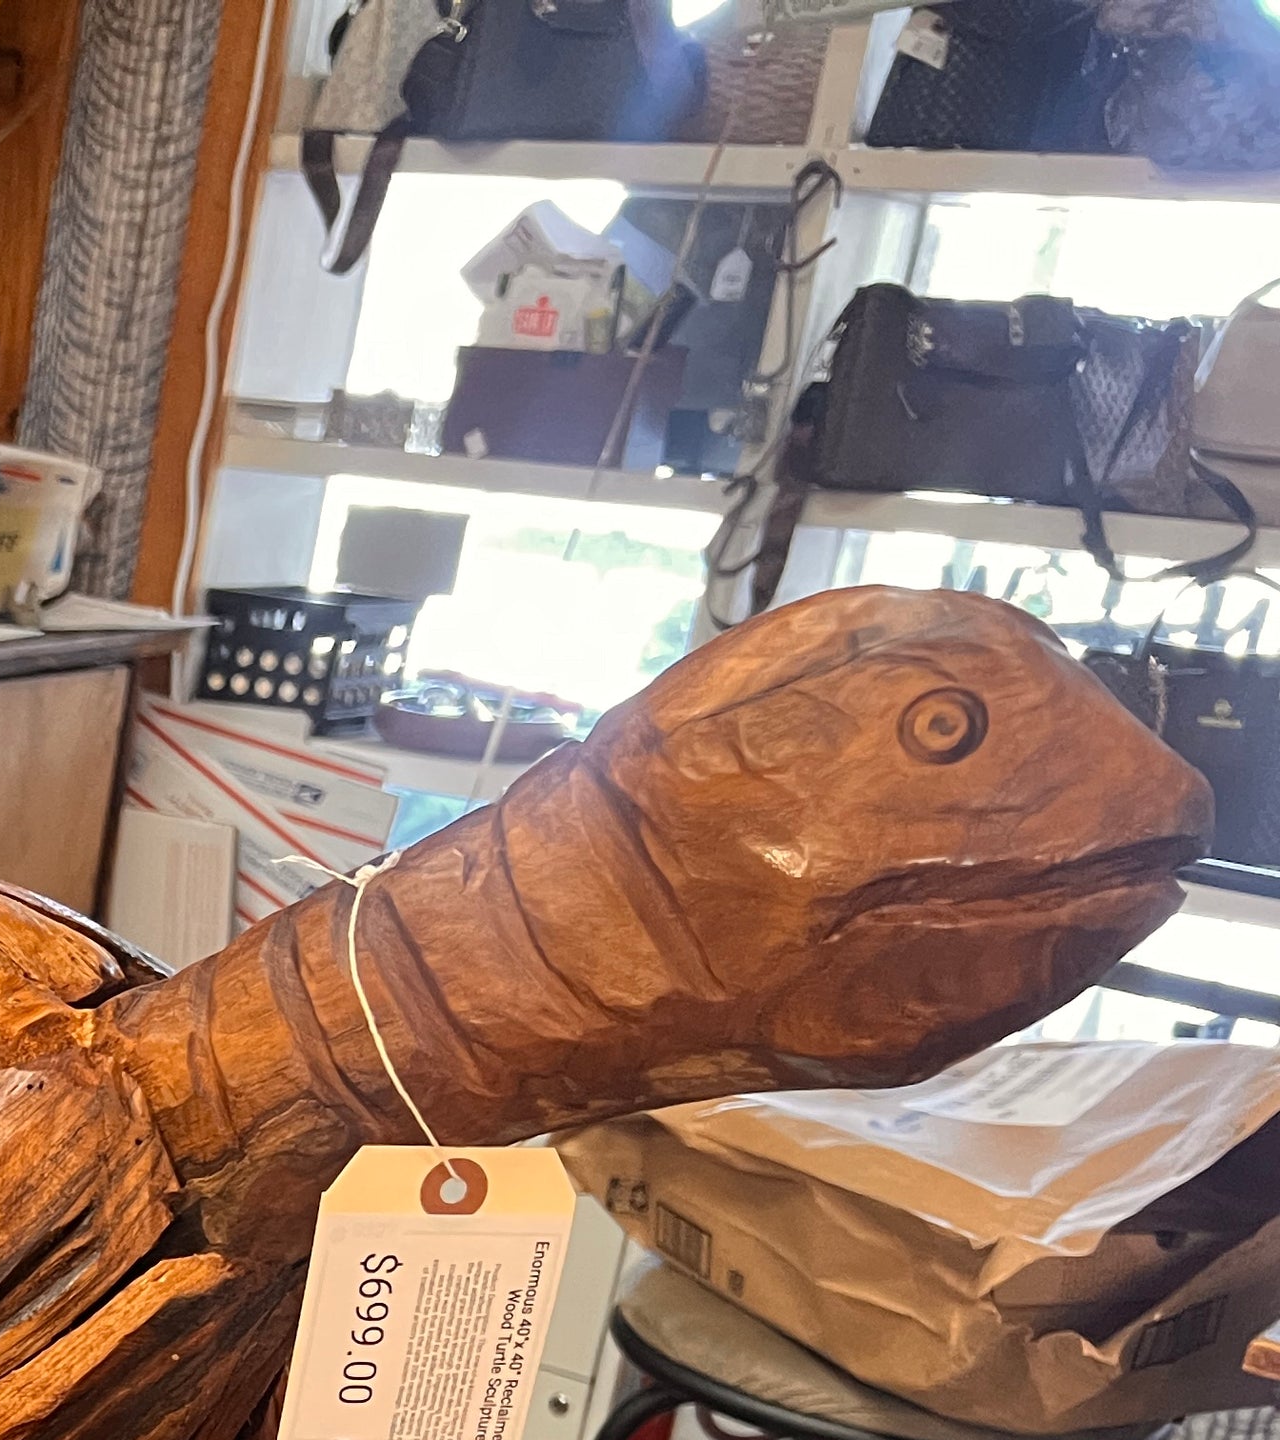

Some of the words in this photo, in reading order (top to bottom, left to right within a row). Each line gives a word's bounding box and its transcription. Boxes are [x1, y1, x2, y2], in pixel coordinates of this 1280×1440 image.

[522, 1242, 550, 1314] Enormous
[339, 1254, 402, 1403] $699.00
[501, 1290, 522, 1329] Wood
[492, 1335, 512, 1373] Turtle
[475, 1379, 501, 1440] Sculpture
